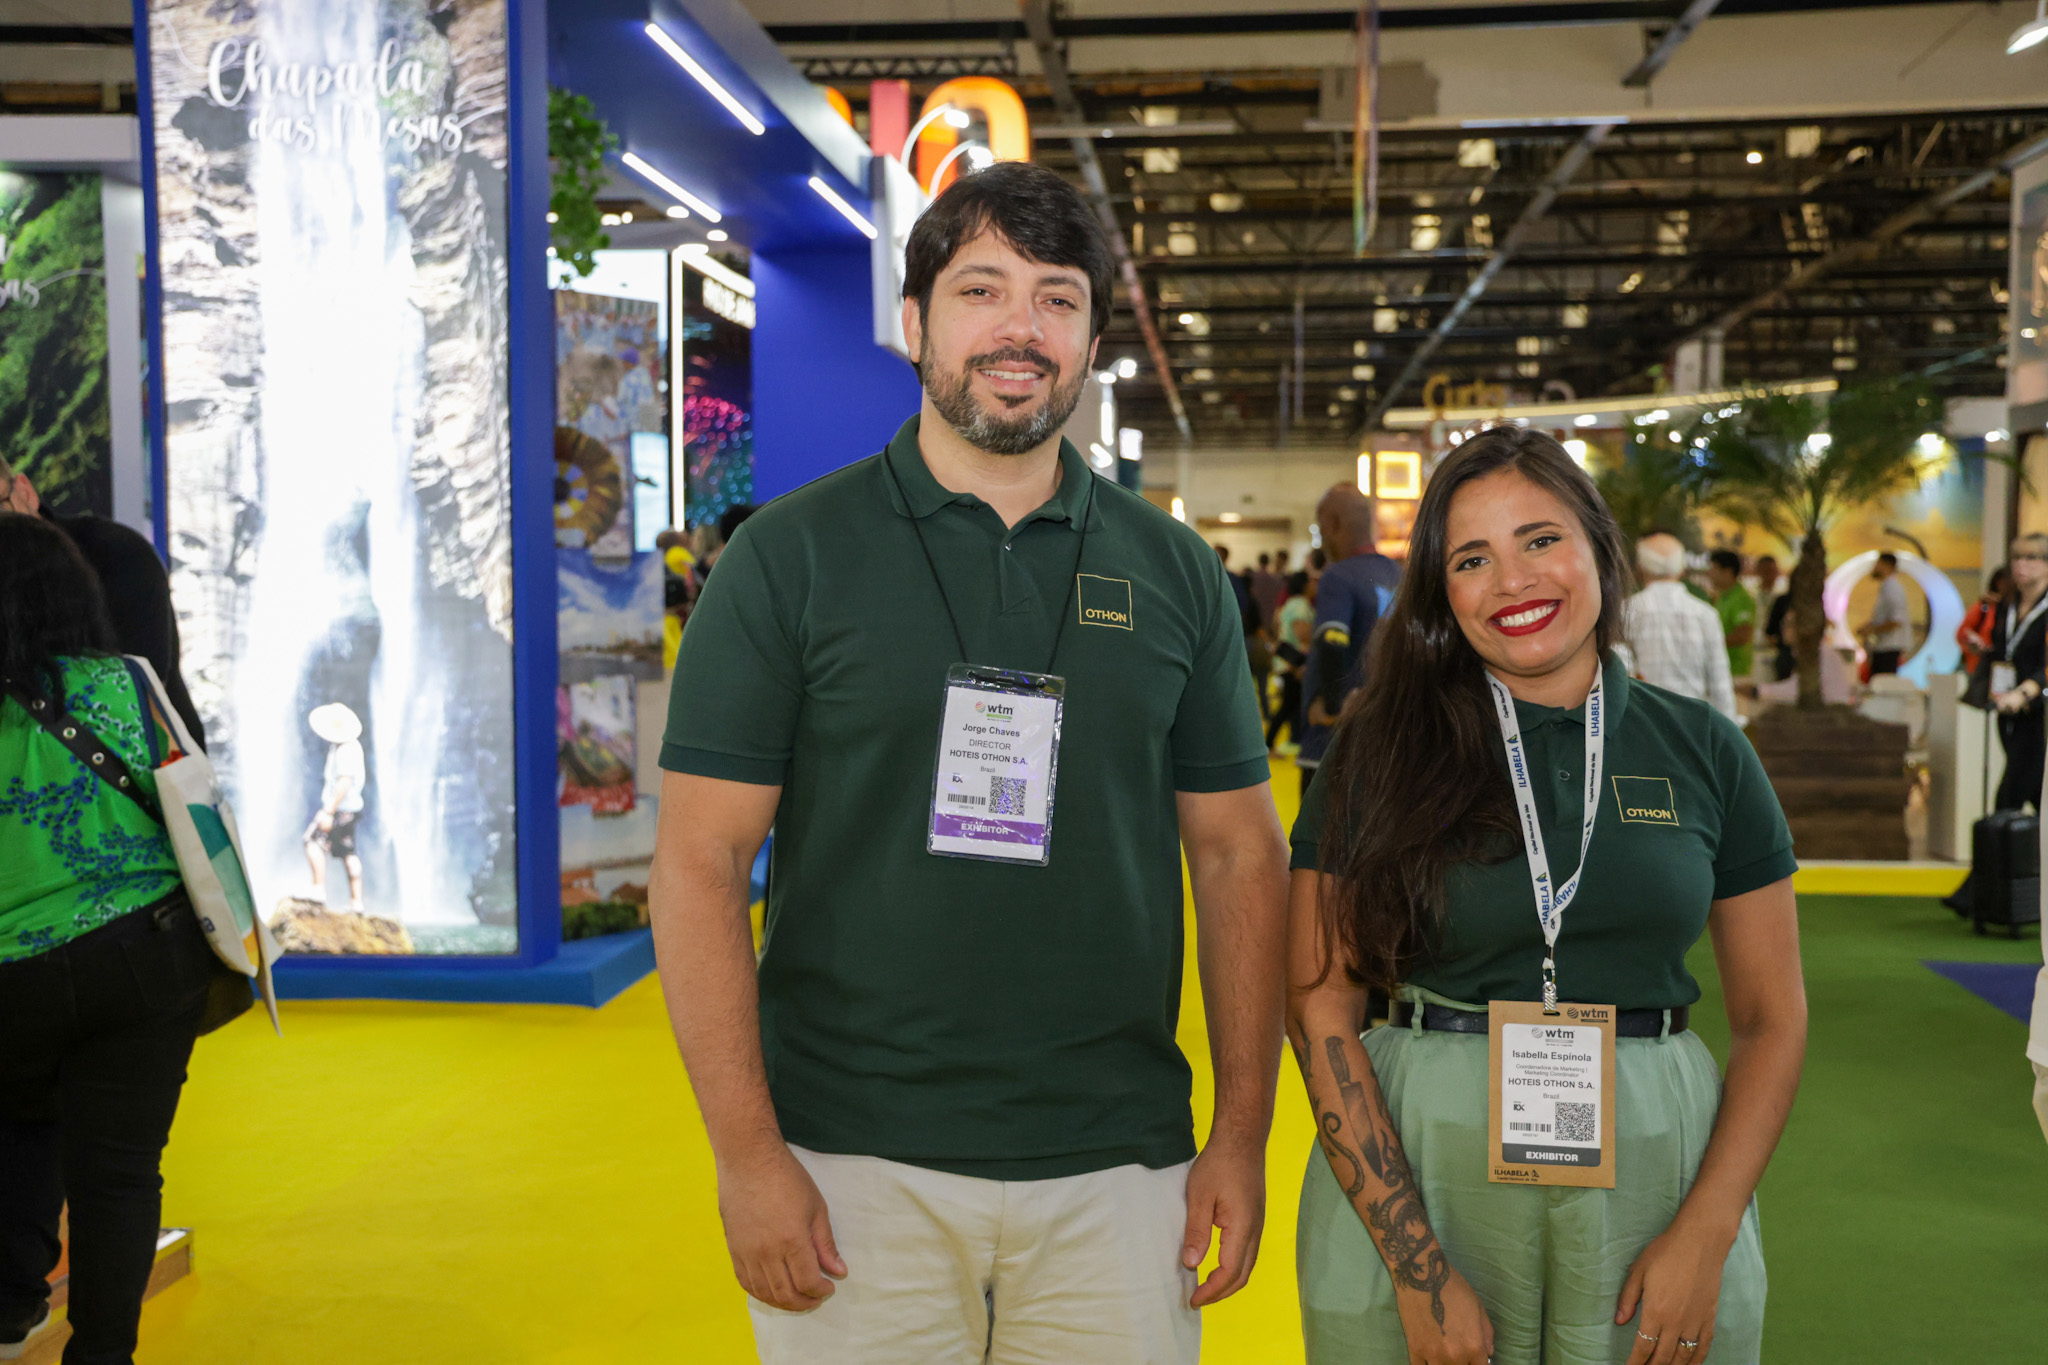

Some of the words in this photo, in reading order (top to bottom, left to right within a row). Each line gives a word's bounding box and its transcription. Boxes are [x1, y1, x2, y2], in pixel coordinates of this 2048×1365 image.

[208, 37, 434, 114] Chapada
[248, 101, 316, 153] das
[330, 100, 464, 153] Mesas
[1085, 608, 1127, 623] OTHON
[987, 703, 1014, 715] wtm
[1590, 695, 1600, 737] ILHABELA
[962, 723, 987, 734] Jorge
[988, 726, 1020, 737] Chaves
[969, 738, 1011, 751] DIRECTOR
[949, 749, 980, 761] HOTEIS
[981, 752, 1010, 763] OTHON
[1511, 746, 1527, 788] ILHABELA
[1626, 807, 1672, 819] OTHON
[961, 822, 1009, 835] EXHIBITOR
[1580, 1008, 1608, 1018] wtm
[1545, 1028, 1575, 1039] wtm
[1512, 1050, 1548, 1060] Isabella
[1551, 1051, 1591, 1062] Espínola
[1516, 1063, 1551, 1071] Coordenadora
[1508, 1078, 1541, 1087] HOTEIS
[1543, 1079, 1575, 1088] OTHON
[1578, 1081, 1595, 1089] S.A.
[1525, 1151, 1579, 1162] EXHIBITOR
[1494, 1169, 1529, 1177] ILHABELA
